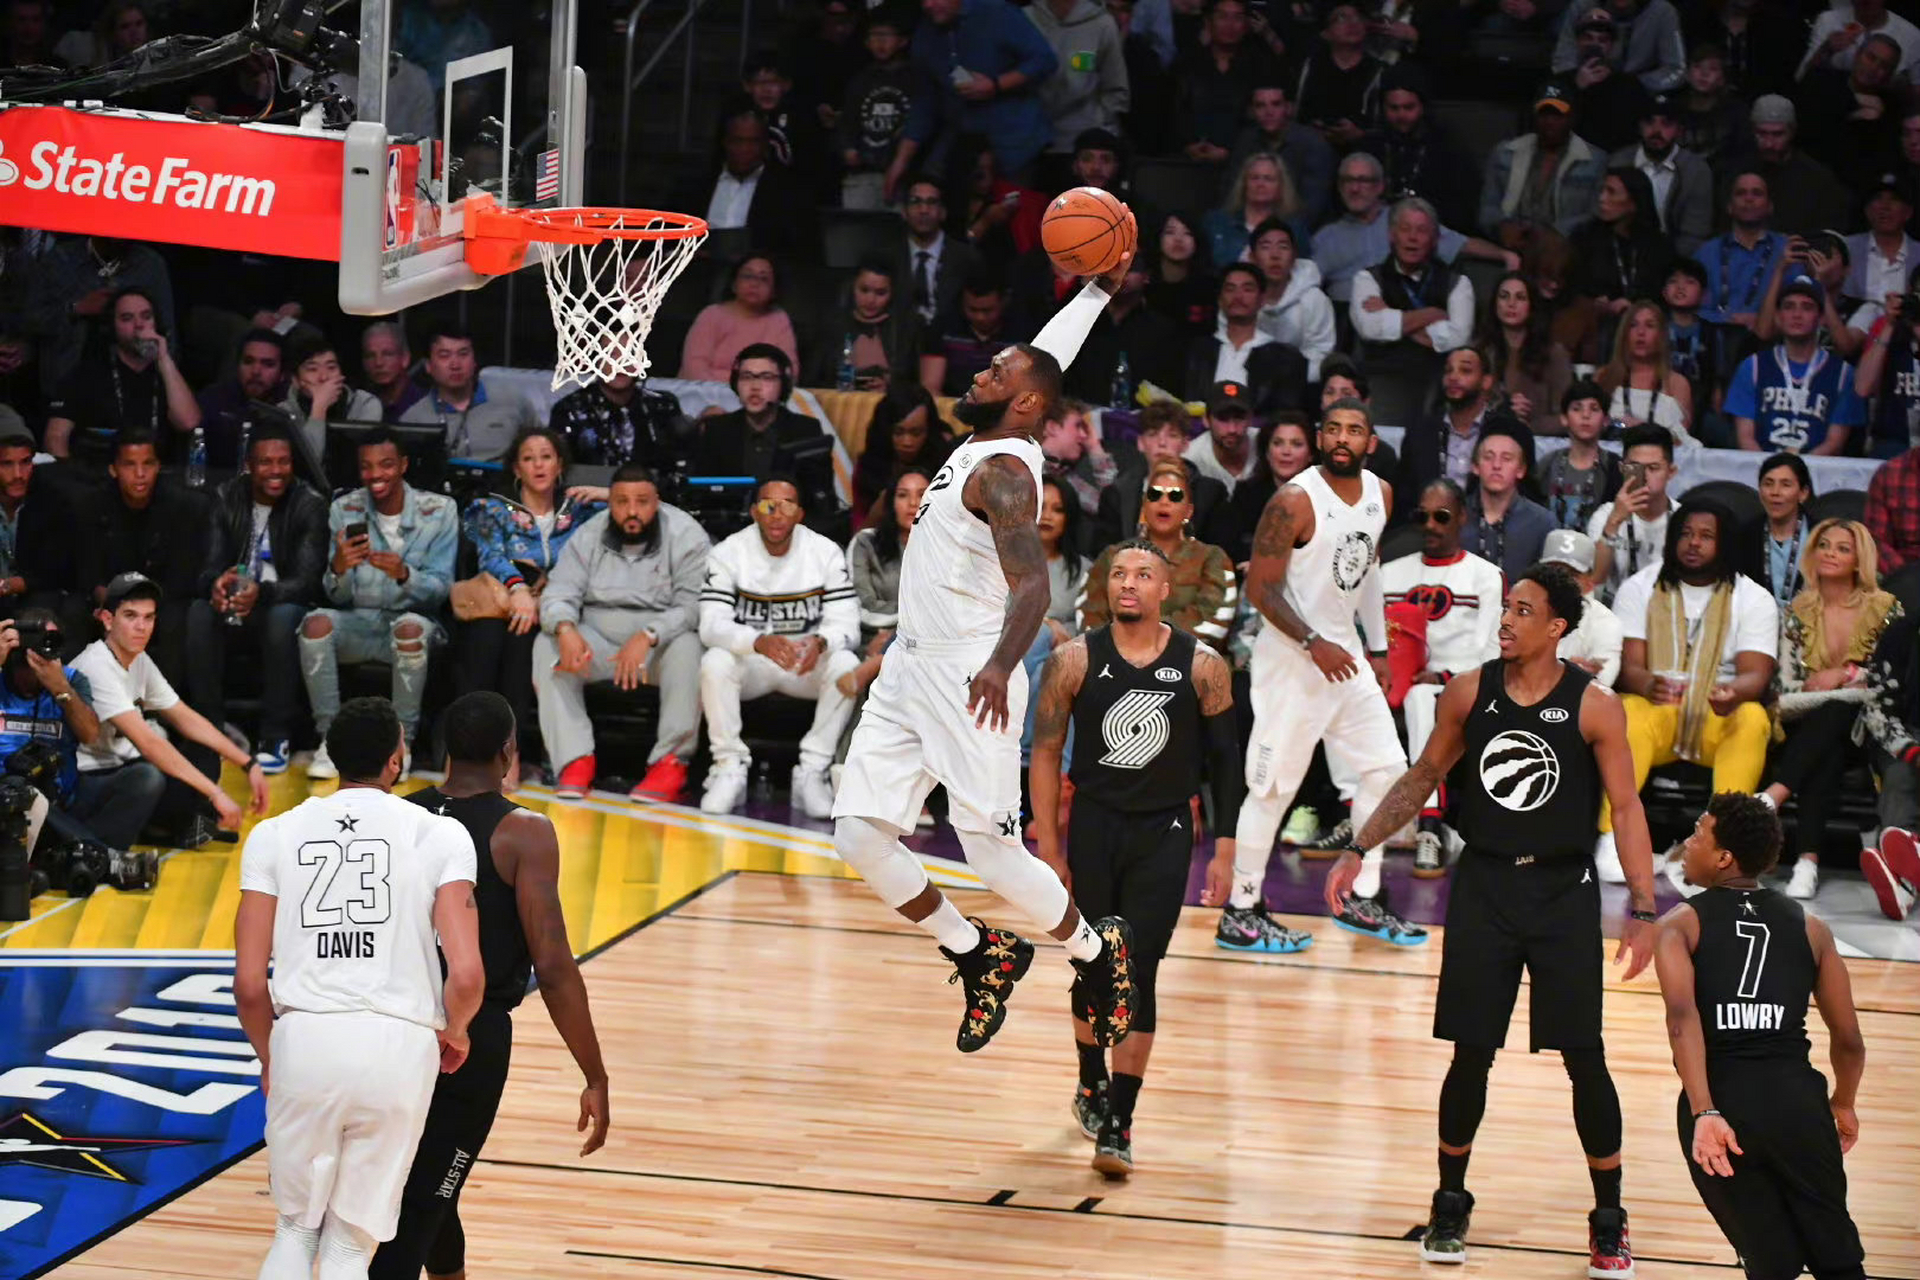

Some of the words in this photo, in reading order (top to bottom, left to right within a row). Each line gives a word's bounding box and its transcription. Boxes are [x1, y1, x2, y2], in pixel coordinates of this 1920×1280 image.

[24, 140, 151, 202] State
[152, 156, 276, 216] Farm
[1769, 416, 1810, 449] 25
[1560, 533, 1575, 553] 3
[1158, 669, 1178, 680] KIA
[1543, 709, 1564, 720] KIA
[298, 839, 391, 928] 23
[317, 931, 375, 958] DAVIS
[1736, 920, 1770, 998] 7
[1716, 1002, 1785, 1030] LOWRY
[435, 1146, 470, 1199] ALL-STAR
